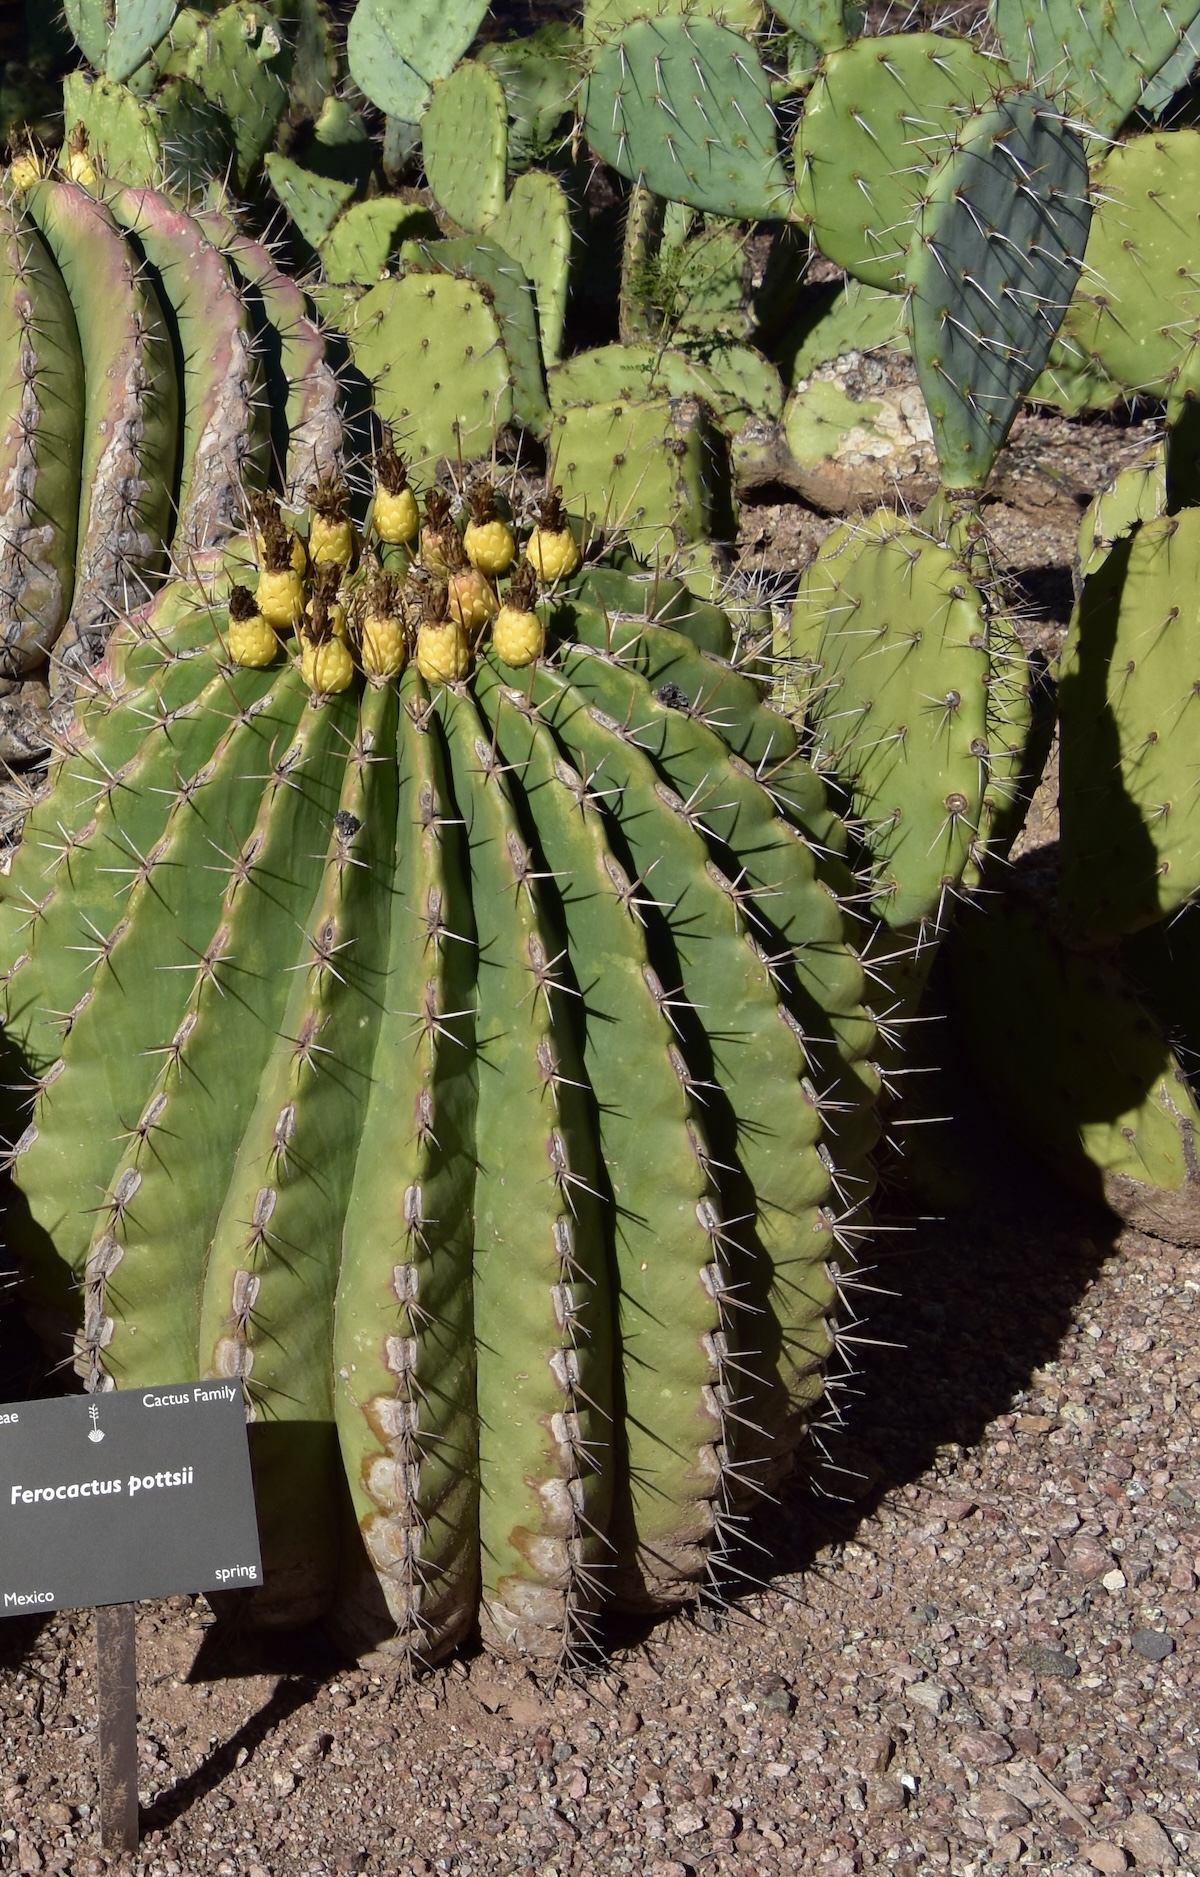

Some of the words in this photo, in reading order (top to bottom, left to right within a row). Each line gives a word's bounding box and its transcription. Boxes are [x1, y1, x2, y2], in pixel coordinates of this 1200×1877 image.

[142, 1393, 190, 1408] Cactus
[193, 1384, 237, 1403] Family
[10, 1479, 122, 1506] Ferocactus
[127, 1465, 194, 1497] pottsii
[214, 1564, 258, 1583] spring
[3, 1590, 55, 1608] Mexico
